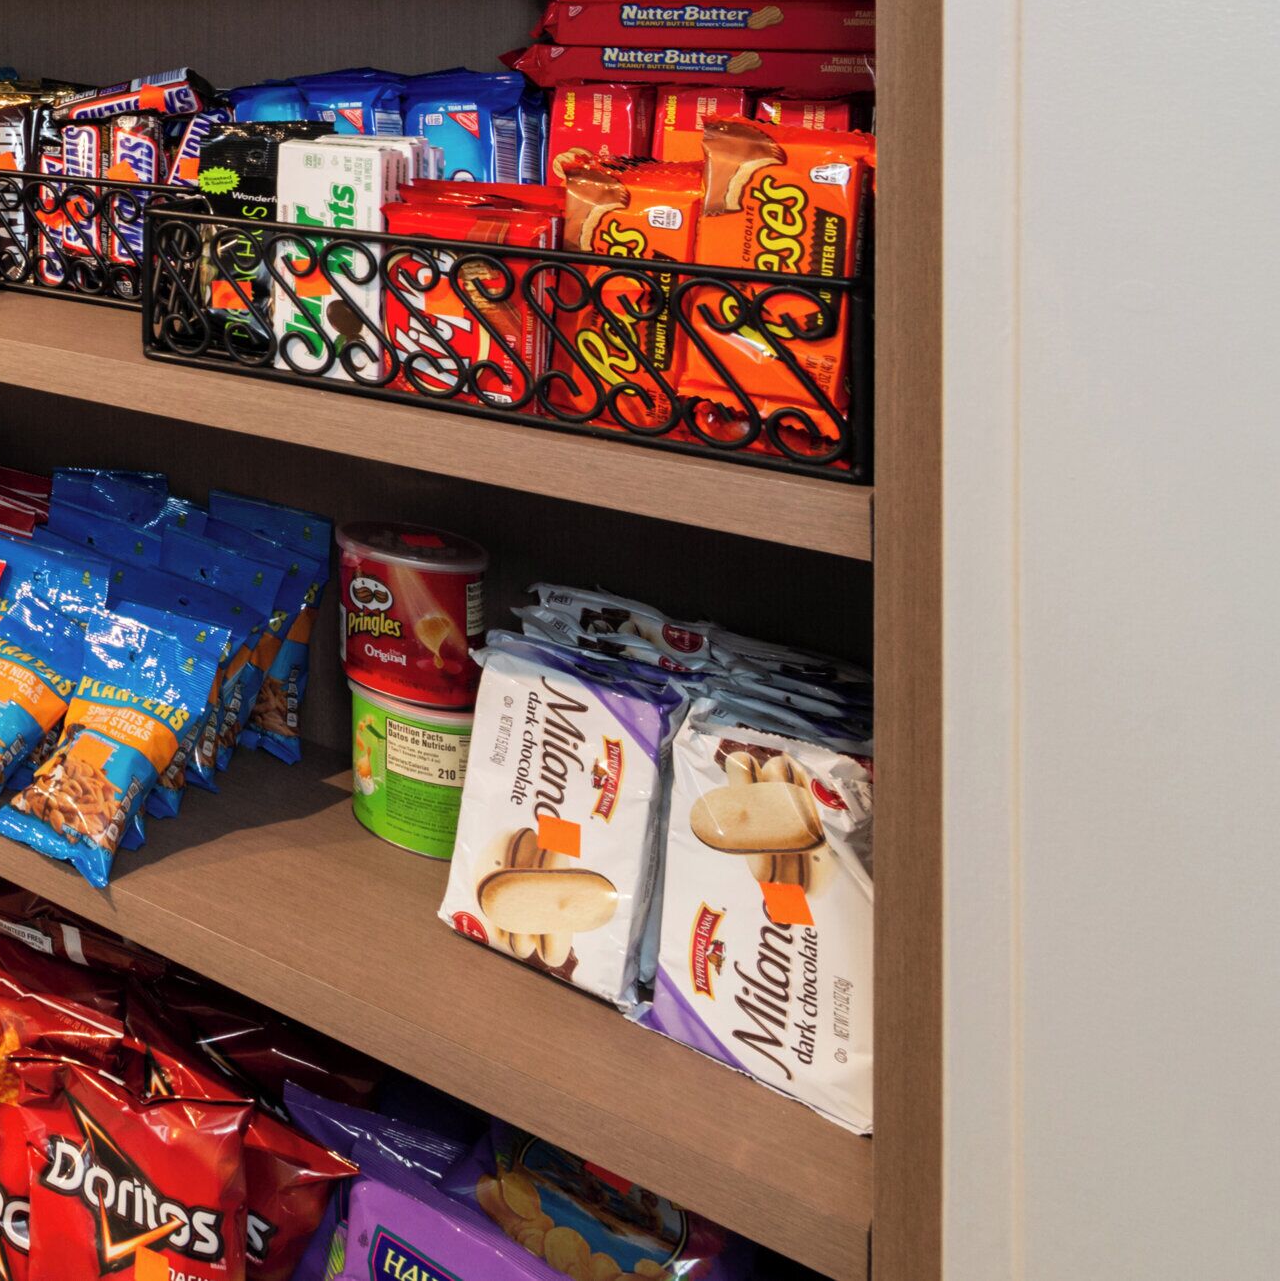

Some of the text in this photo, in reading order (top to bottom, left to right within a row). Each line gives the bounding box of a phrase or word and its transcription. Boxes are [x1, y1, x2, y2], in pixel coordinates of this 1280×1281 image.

[622, 5, 748, 21] Nutter Butter
[604, 48, 728, 65] Nutter Butter
[564, 92, 576, 119] Cookies
[665, 95, 677, 123] Cookies
[652, 209, 665, 227] 210
[743, 204, 754, 261] CHOCOLATE
[655, 320, 668, 360] PEANUT
[348, 612, 402, 638] Pringles
[365, 643, 407, 667] Original
[11, 665, 36, 686] NUTS
[77, 676, 190, 731] PLANTERS
[109, 717, 152, 741] STICKS
[113, 708, 144, 726] NUTS
[388, 720, 444, 742] Nutrition Facts
[388, 728, 409, 742] Datos
[510, 691, 541, 806] dark chocolate
[438, 768, 456, 781] 210
[596, 745, 623, 819] PEPPERIDGE FARM
[695, 910, 717, 991] PEPPERIDGE FARM
[790, 927, 819, 1065] dark chocolate
[45, 1141, 220, 1255] Doritos
